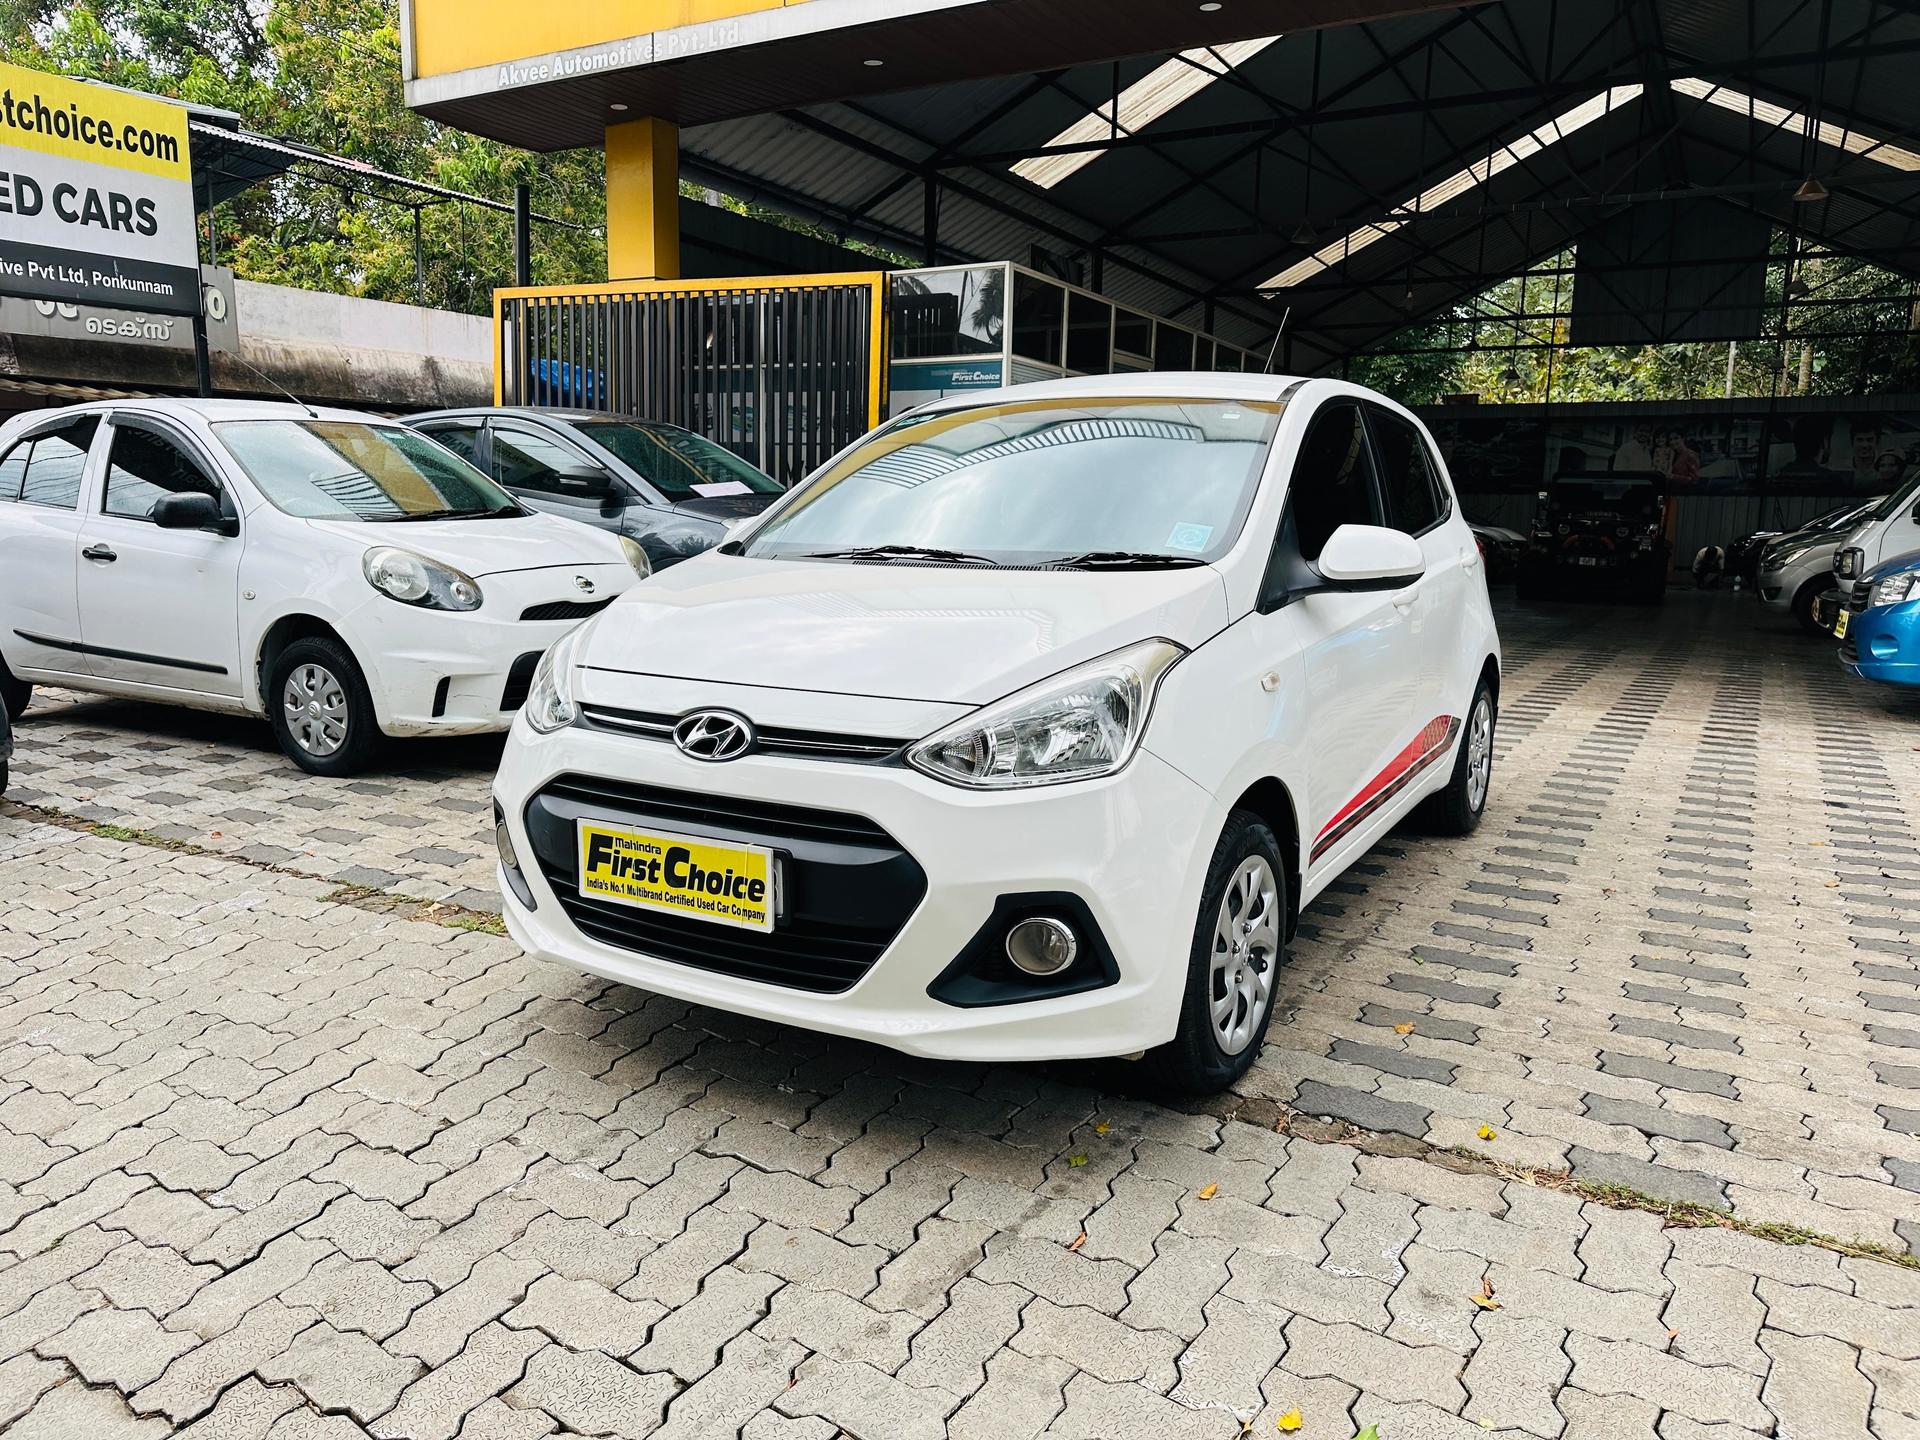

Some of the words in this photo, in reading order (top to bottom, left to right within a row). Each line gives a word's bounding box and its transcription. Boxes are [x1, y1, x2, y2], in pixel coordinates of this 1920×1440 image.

[499, 65, 548, 86] Akvee
[552, 42, 662, 77] Automotives
[667, 32, 704, 54] Pvt.
[708, 22, 744, 46] Ltd.
[0, 88, 179, 163] tchoice.com
[52, 182, 158, 237] CARS
[28, 261, 55, 280] Pvt
[58, 265, 89, 287] Ltd,
[93, 271, 174, 295] Ponkunnam
[951, 372, 973, 381] First
[973, 371, 1000, 381] Choice
[587, 832, 662, 884] First
[664, 846, 766, 903] Choice
[615, 837, 662, 855] Mahindra
[586, 876, 609, 891] India's
[610, 881, 625, 894] No.1
[627, 884, 663, 901] Multibrand
[664, 891, 695, 907] Certified
[697, 897, 715, 911] Used
[717, 901, 730, 914] Car
[732, 903, 766, 923] Company
